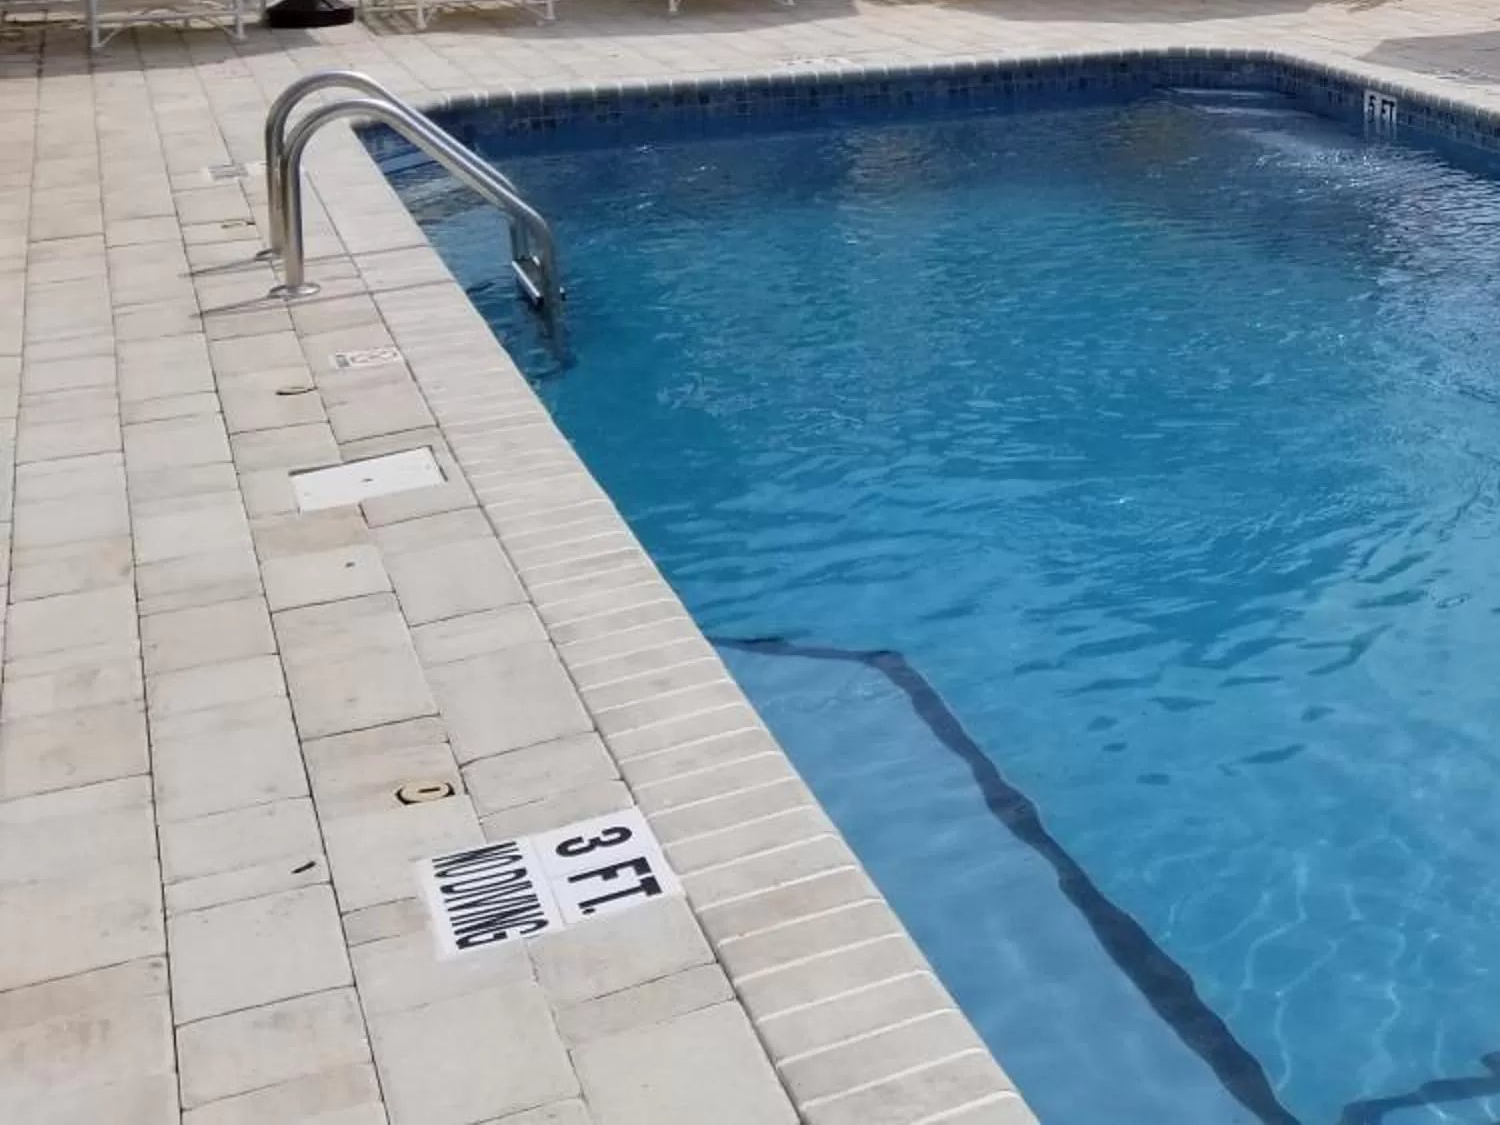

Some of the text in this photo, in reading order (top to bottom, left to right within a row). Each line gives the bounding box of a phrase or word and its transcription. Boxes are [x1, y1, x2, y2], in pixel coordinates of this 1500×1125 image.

[1381, 98, 1395, 119] FT
[555, 826, 633, 858] 3
[432, 840, 549, 950] NO DIVING
